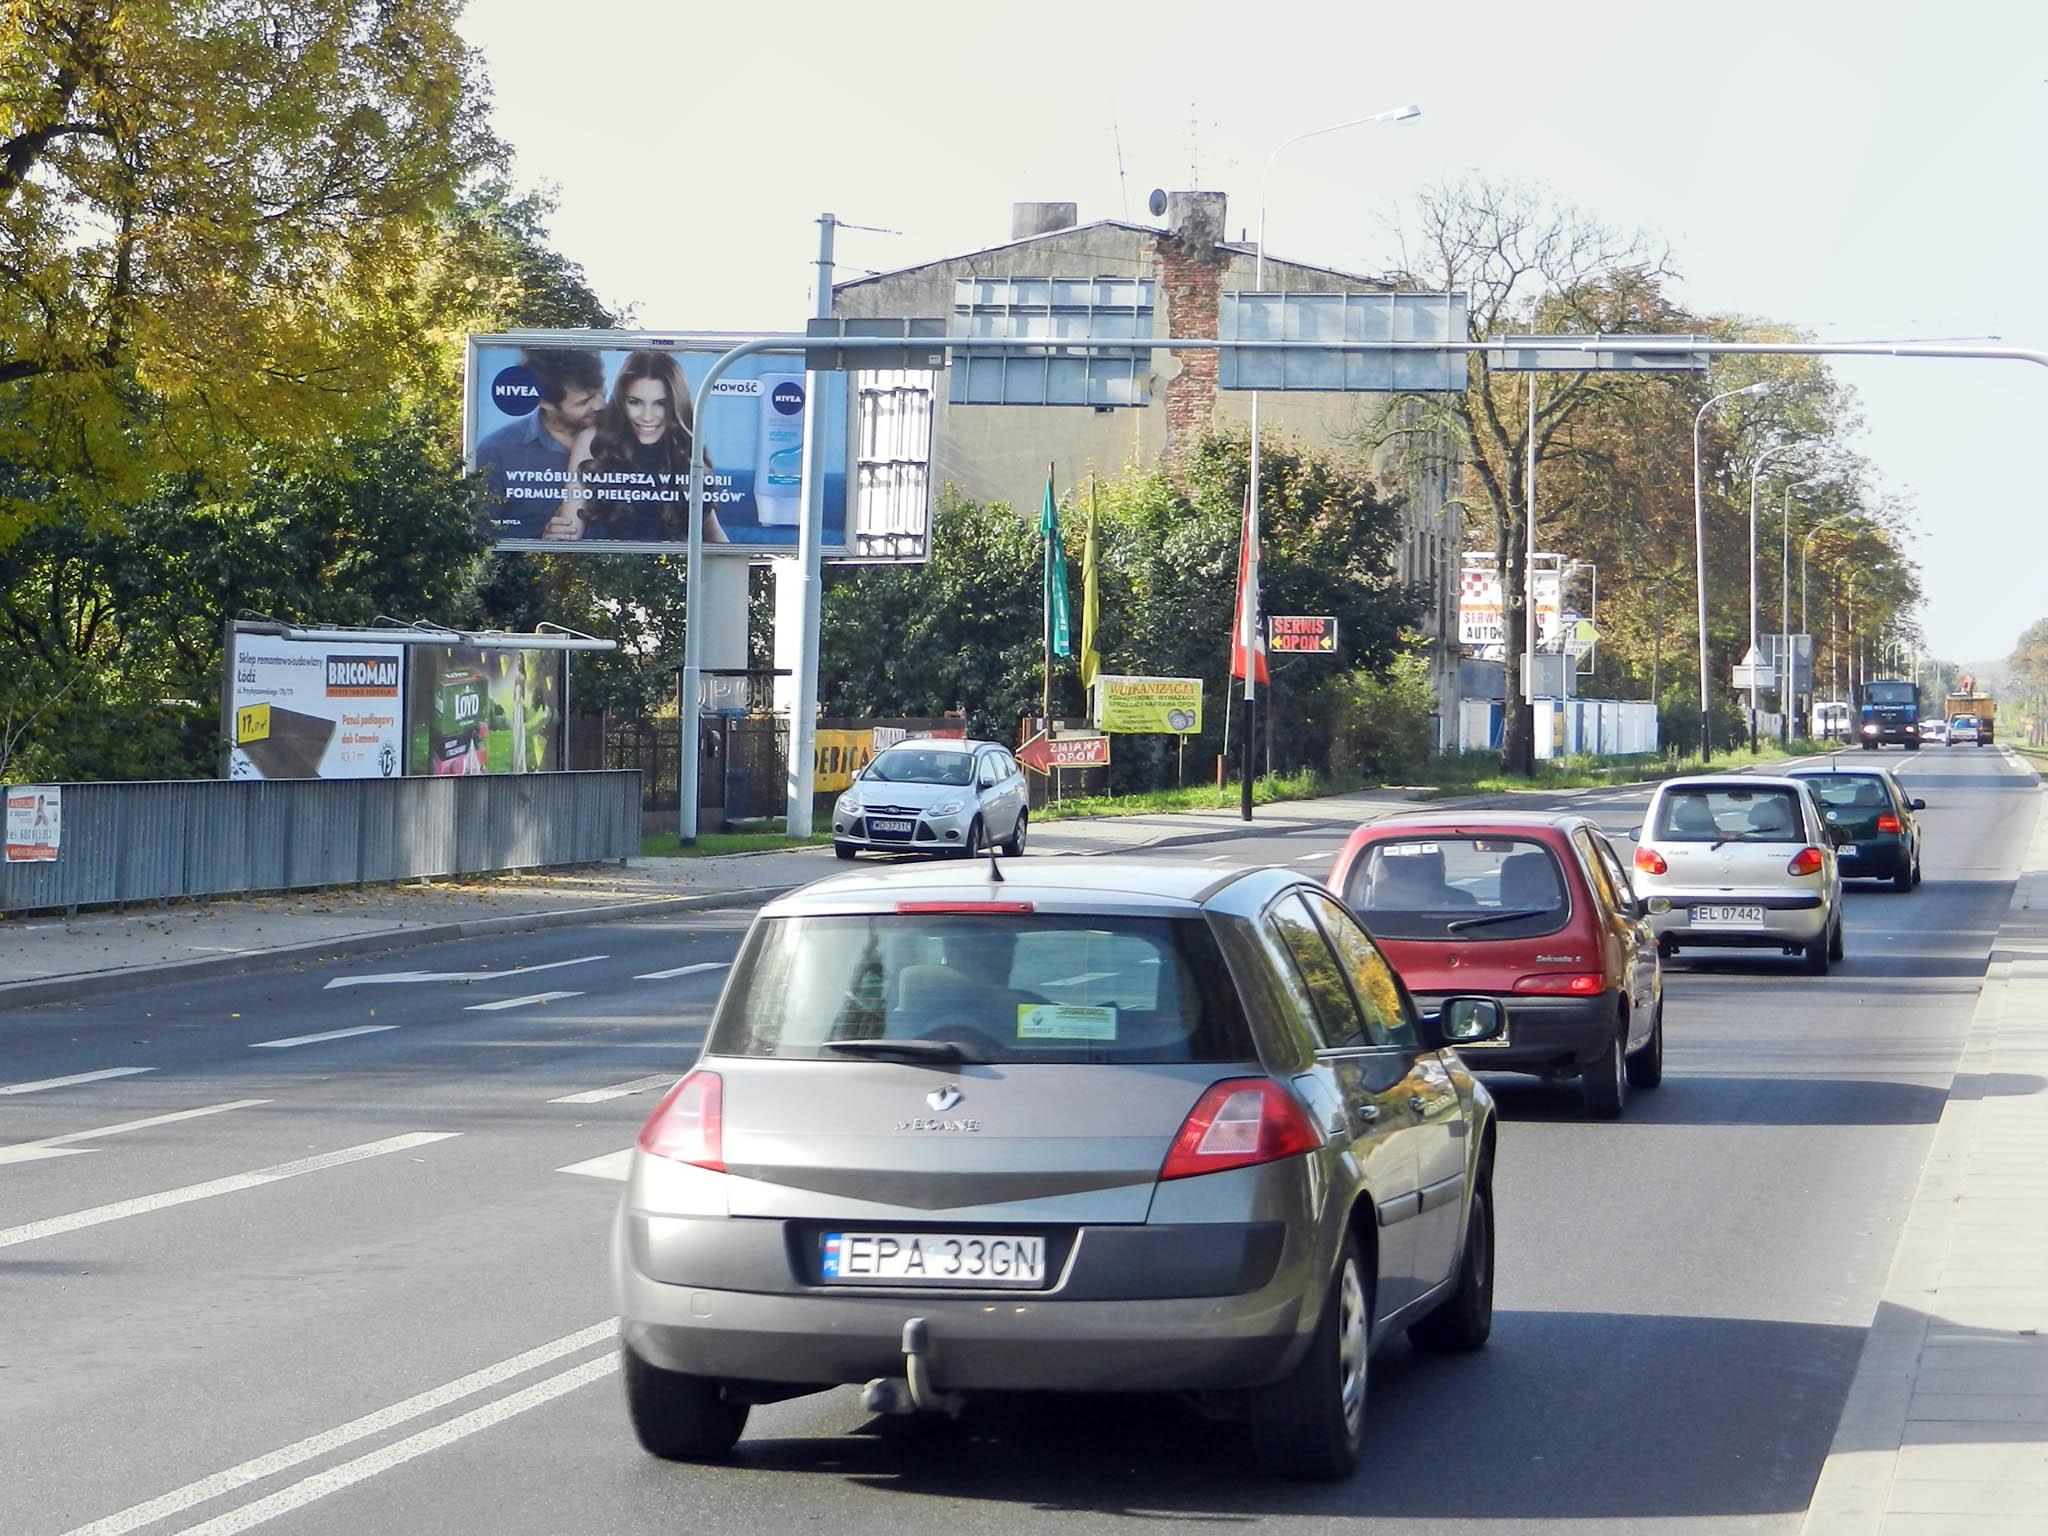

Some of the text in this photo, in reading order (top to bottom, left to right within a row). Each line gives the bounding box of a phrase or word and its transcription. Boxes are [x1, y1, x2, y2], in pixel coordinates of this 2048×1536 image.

[495, 386, 540, 397] NIVEA
[712, 382, 757, 392] NOWOŚĆ
[775, 395, 802, 403] NIVEA
[506, 468, 732, 487] WYPRÓBUJ NAJLEPSZĄ W HIORII
[506, 488, 568, 501] FORMUŁĘ
[573, 488, 593, 500] DO
[597, 489, 680, 504] PIELĘGNACJI
[1274, 618, 1325, 634] SERWIS
[1282, 635, 1319, 650] OPON
[328, 662, 396, 685] BRICOMAN
[1110, 683, 1195, 696] WULKANIZACJA
[455, 693, 480, 720] LOYD
[1050, 740, 1102, 753] ZMIANA
[1056, 751, 1096, 762] OPON
[1699, 907, 1761, 921] EL 07442
[849, 1237, 1037, 1277] EPA 33GN
